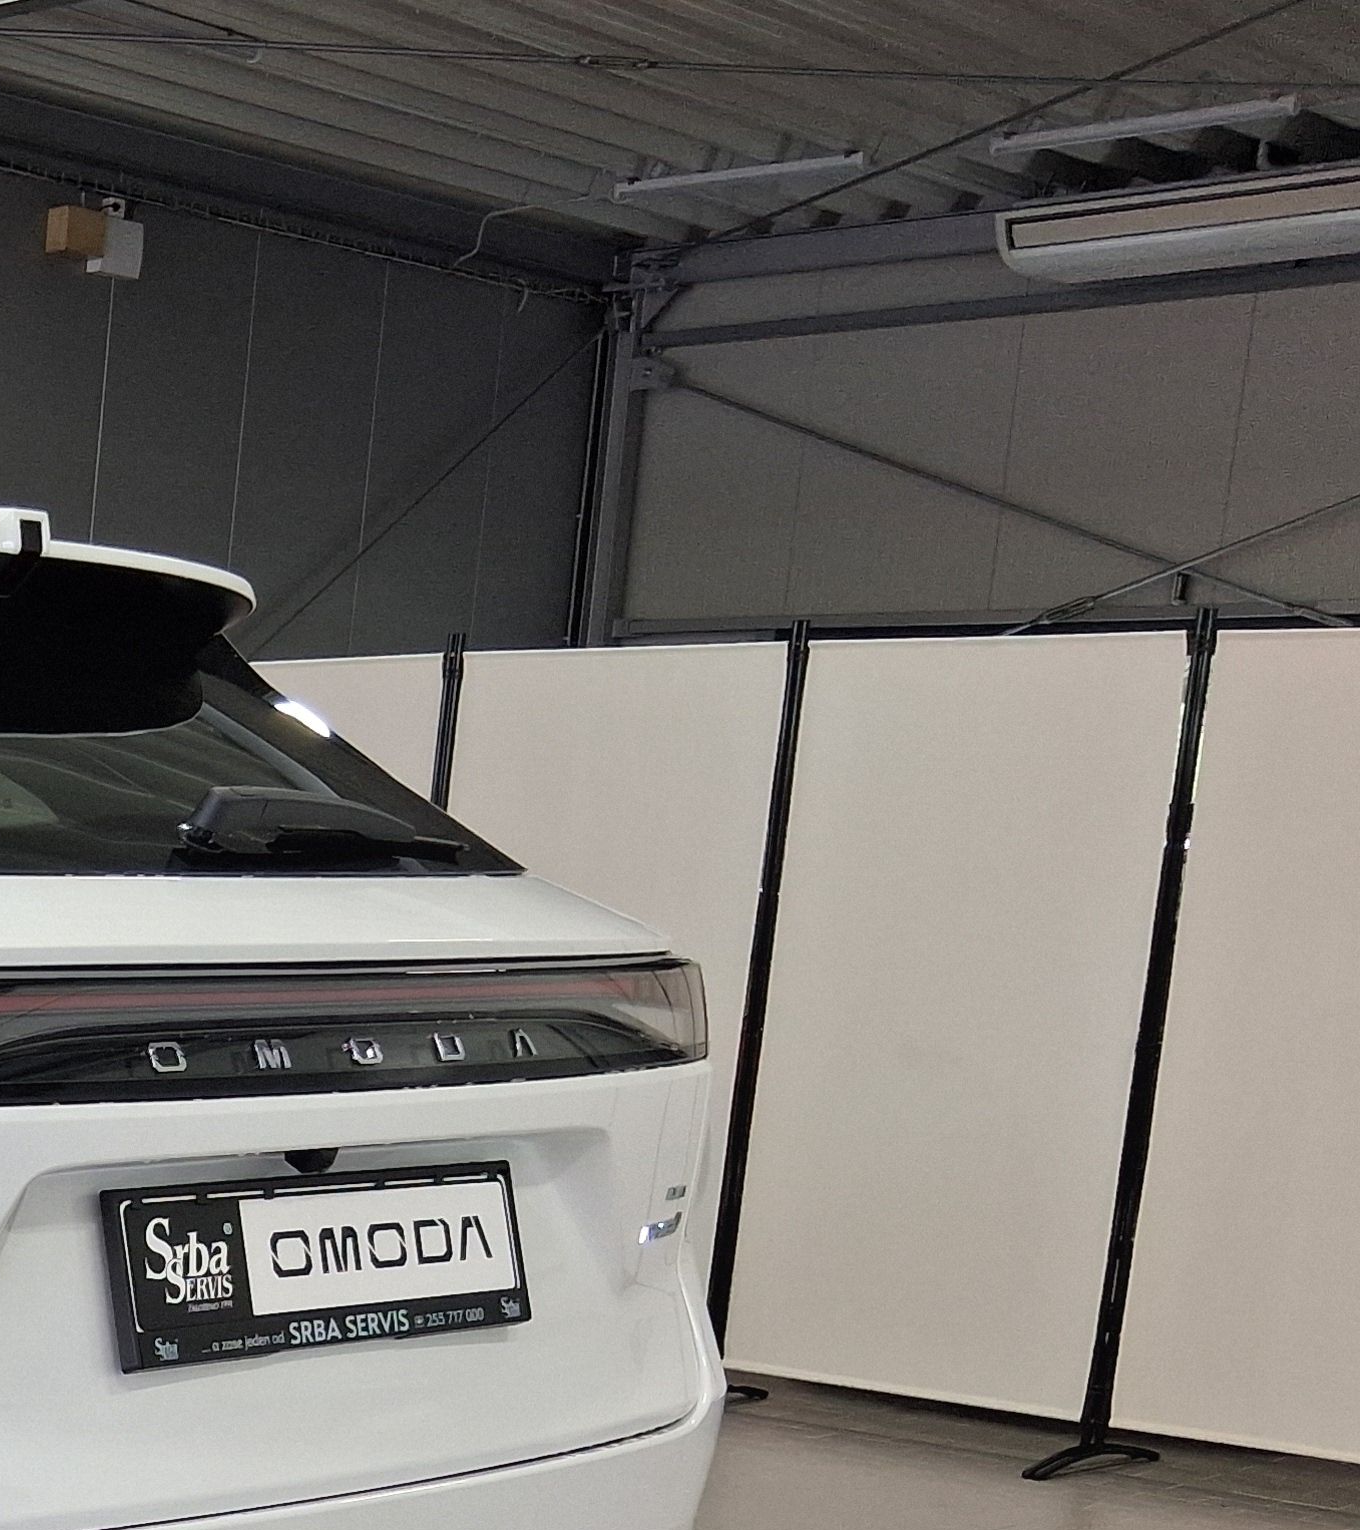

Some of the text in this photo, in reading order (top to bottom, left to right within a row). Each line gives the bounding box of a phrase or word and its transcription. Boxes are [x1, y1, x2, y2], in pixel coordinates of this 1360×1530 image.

[147, 1027, 539, 1073] OMODA
[144, 1216, 231, 1280] Srba
[268, 1214, 494, 1278] OMODA
[164, 1257, 233, 1304] SERVIS
[288, 1317, 342, 1345] SRBA
[346, 1308, 410, 1338] SERVIS
